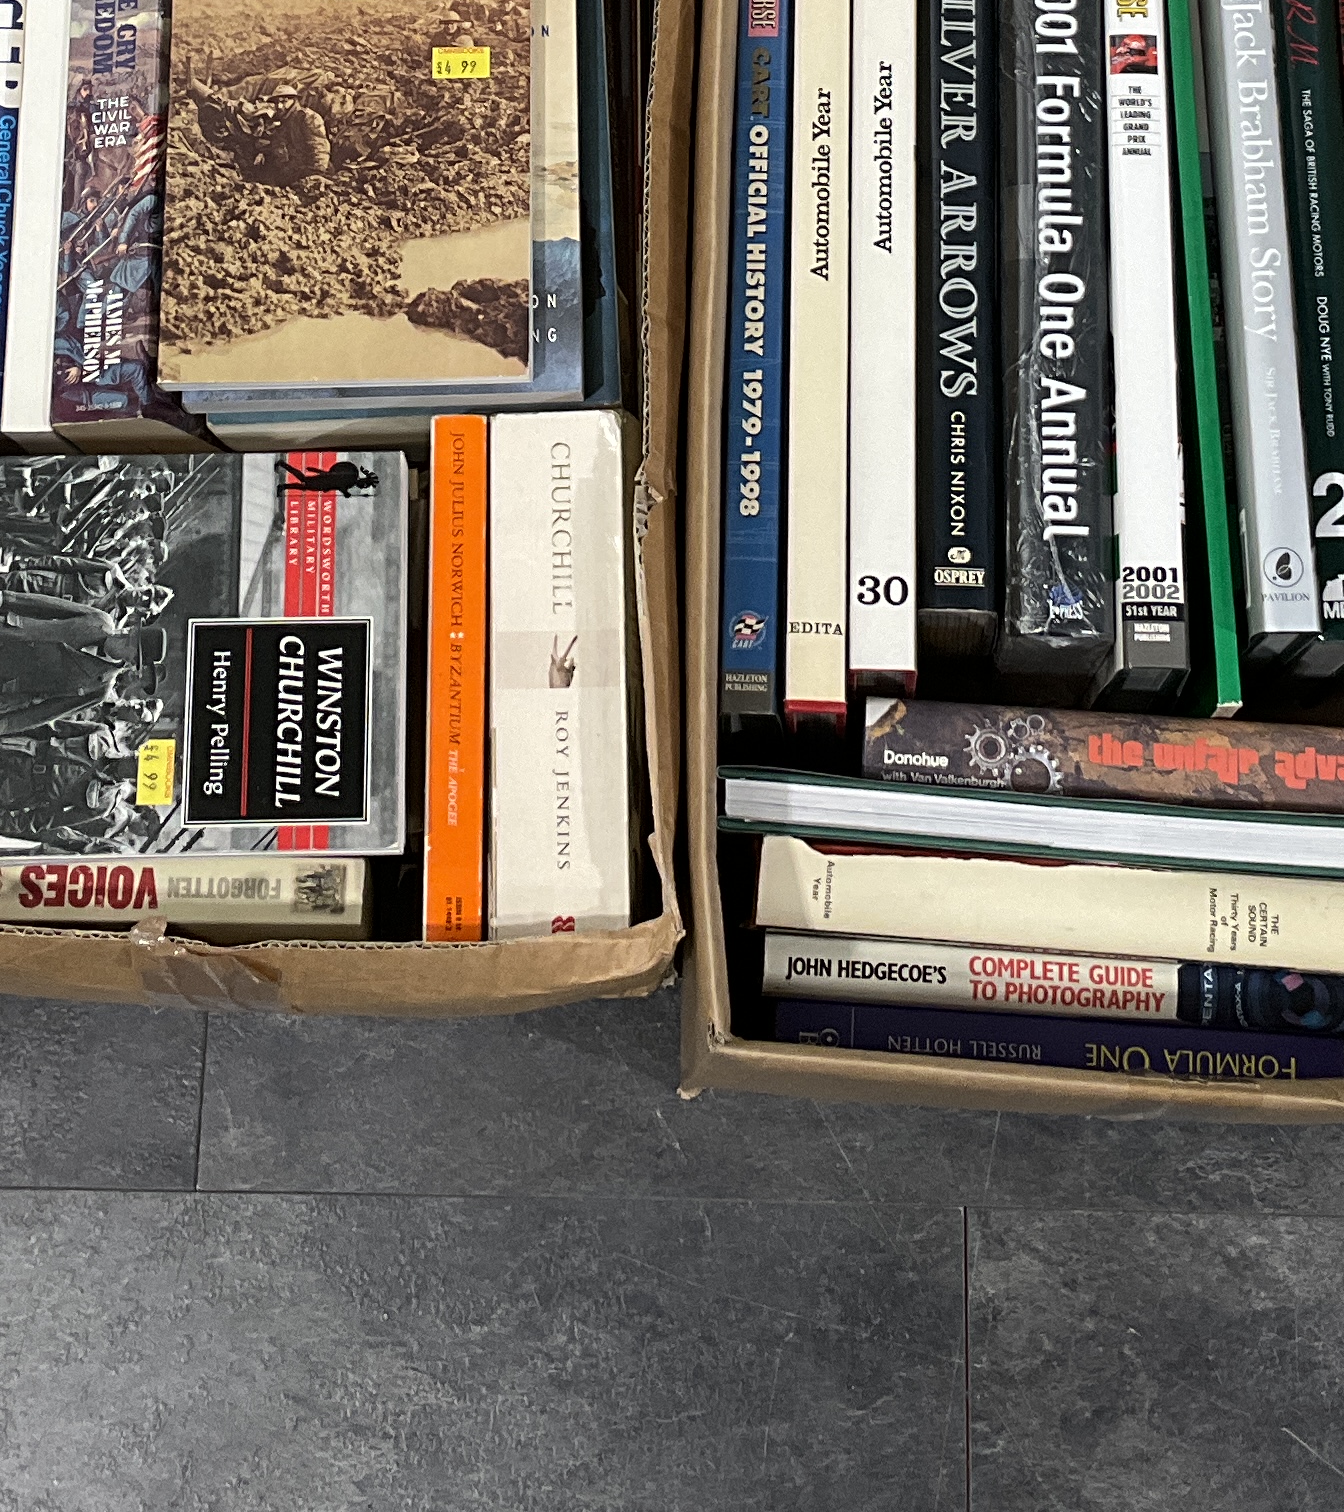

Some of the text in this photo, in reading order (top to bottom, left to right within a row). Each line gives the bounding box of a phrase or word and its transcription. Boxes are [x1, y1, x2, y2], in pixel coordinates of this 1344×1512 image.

[1034, 74, 1081, 260] Formula
[740, 125, 770, 516] OFFICIAL HISTORY 1979-1998
[939, 162, 979, 396] ARROWS
[1041, 271, 1084, 362] One
[551, 442, 570, 616] CHURCHILL
[949, 410, 965, 535] CHRIS NIXON
[1042, 378, 1090, 540] Annual
[858, 576, 908, 605] 30
[206, 651, 229, 795] Henry Pelling
[276, 637, 304, 809] CHURCHILL
[312, 646, 342, 798] WINSTON
[554, 710, 570, 870] ROY JENKINS
[884, 749, 949, 766] Donohue
[787, 957, 1154, 988] JOHN HEDGECOE'S COMPLETE GUIDE
[970, 979, 1165, 1013] TO PHOTOGRAPHY
